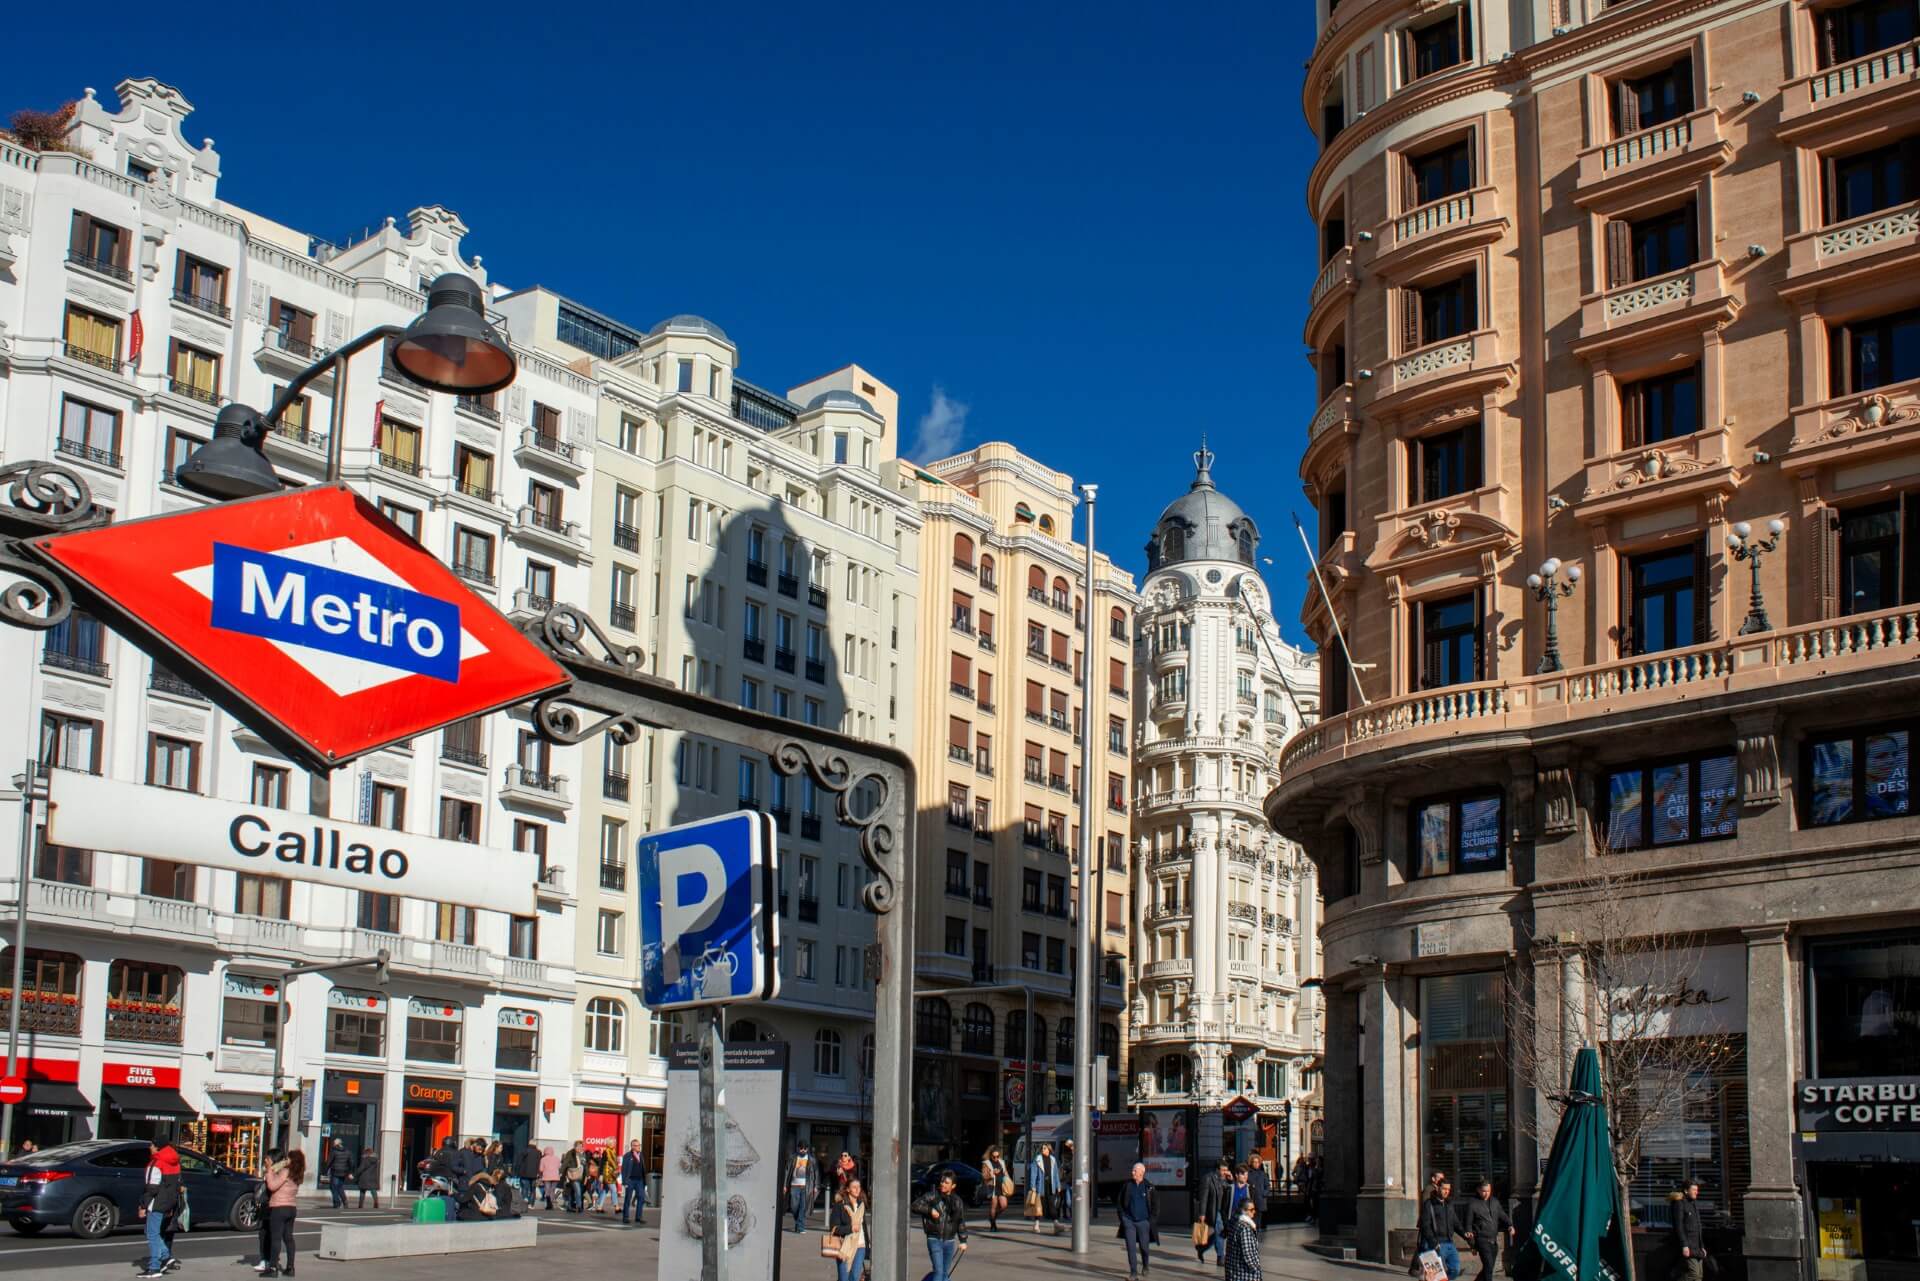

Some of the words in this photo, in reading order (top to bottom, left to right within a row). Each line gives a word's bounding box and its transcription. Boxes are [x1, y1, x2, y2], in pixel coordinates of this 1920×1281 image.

[240, 561, 444, 658] Metro
[229, 814, 410, 880] Callao
[659, 843, 728, 985] P
[126, 1075, 156, 1085] GUYS
[129, 1067, 153, 1076] FIVE
[409, 1084, 453, 1102] Orange
[1803, 1083, 1920, 1103] STARBU
